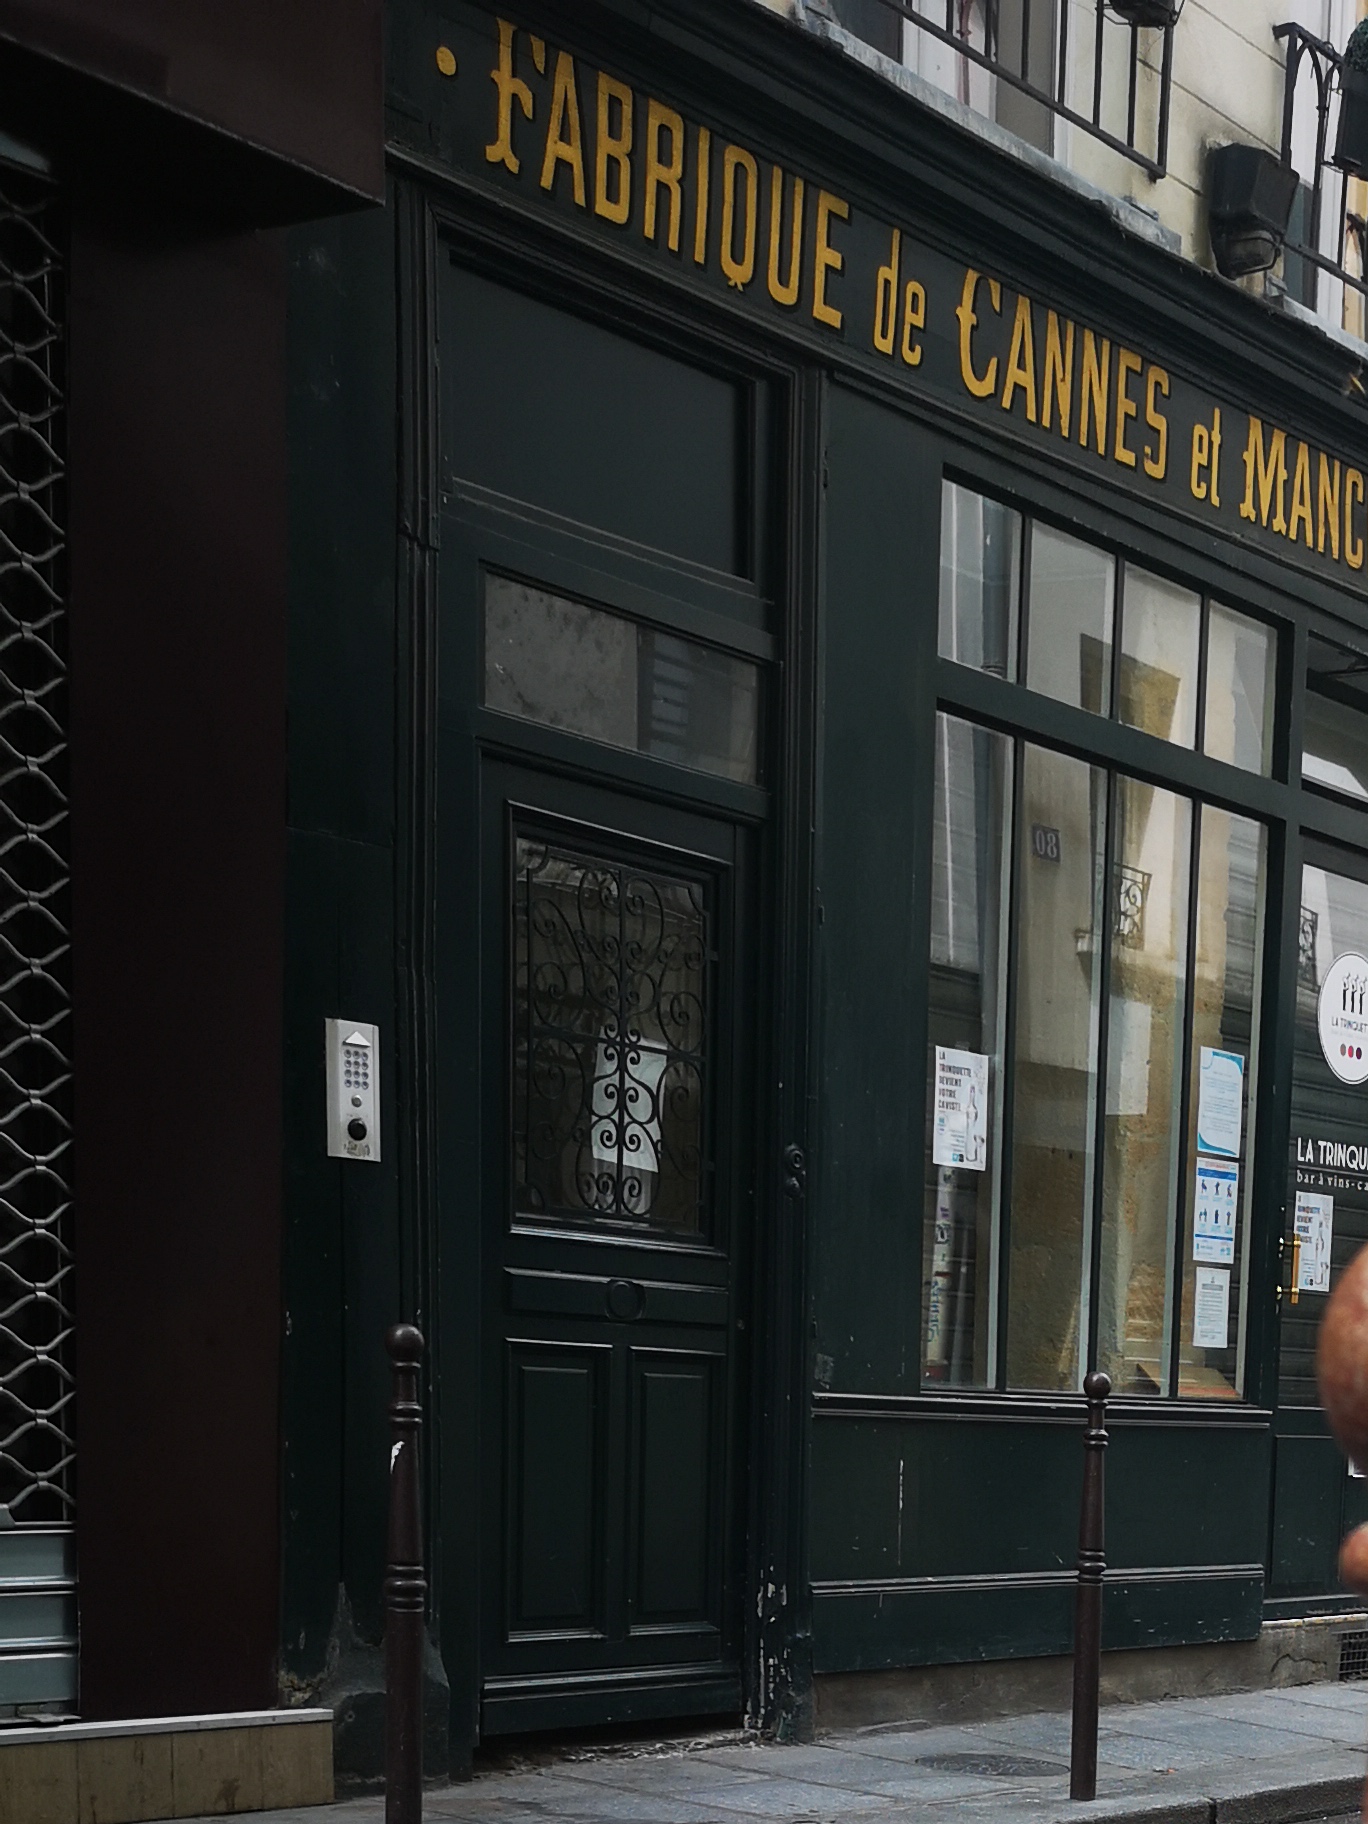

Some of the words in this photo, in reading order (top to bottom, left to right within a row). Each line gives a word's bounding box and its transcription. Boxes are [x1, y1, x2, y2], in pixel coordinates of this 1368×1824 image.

[485, 17, 850, 330] FABRIQUE
[873, 228, 926, 367] de
[954, 268, 1171, 481] CANNES
[1189, 406, 1222, 508] et
[1331, 1016, 1339, 1027] LA
[939, 1051, 945, 1060] LA
[1296, 1136, 1314, 1164] LA
[1296, 1169, 1315, 1185] bar
[1318, 1172, 1324, 1186] à
